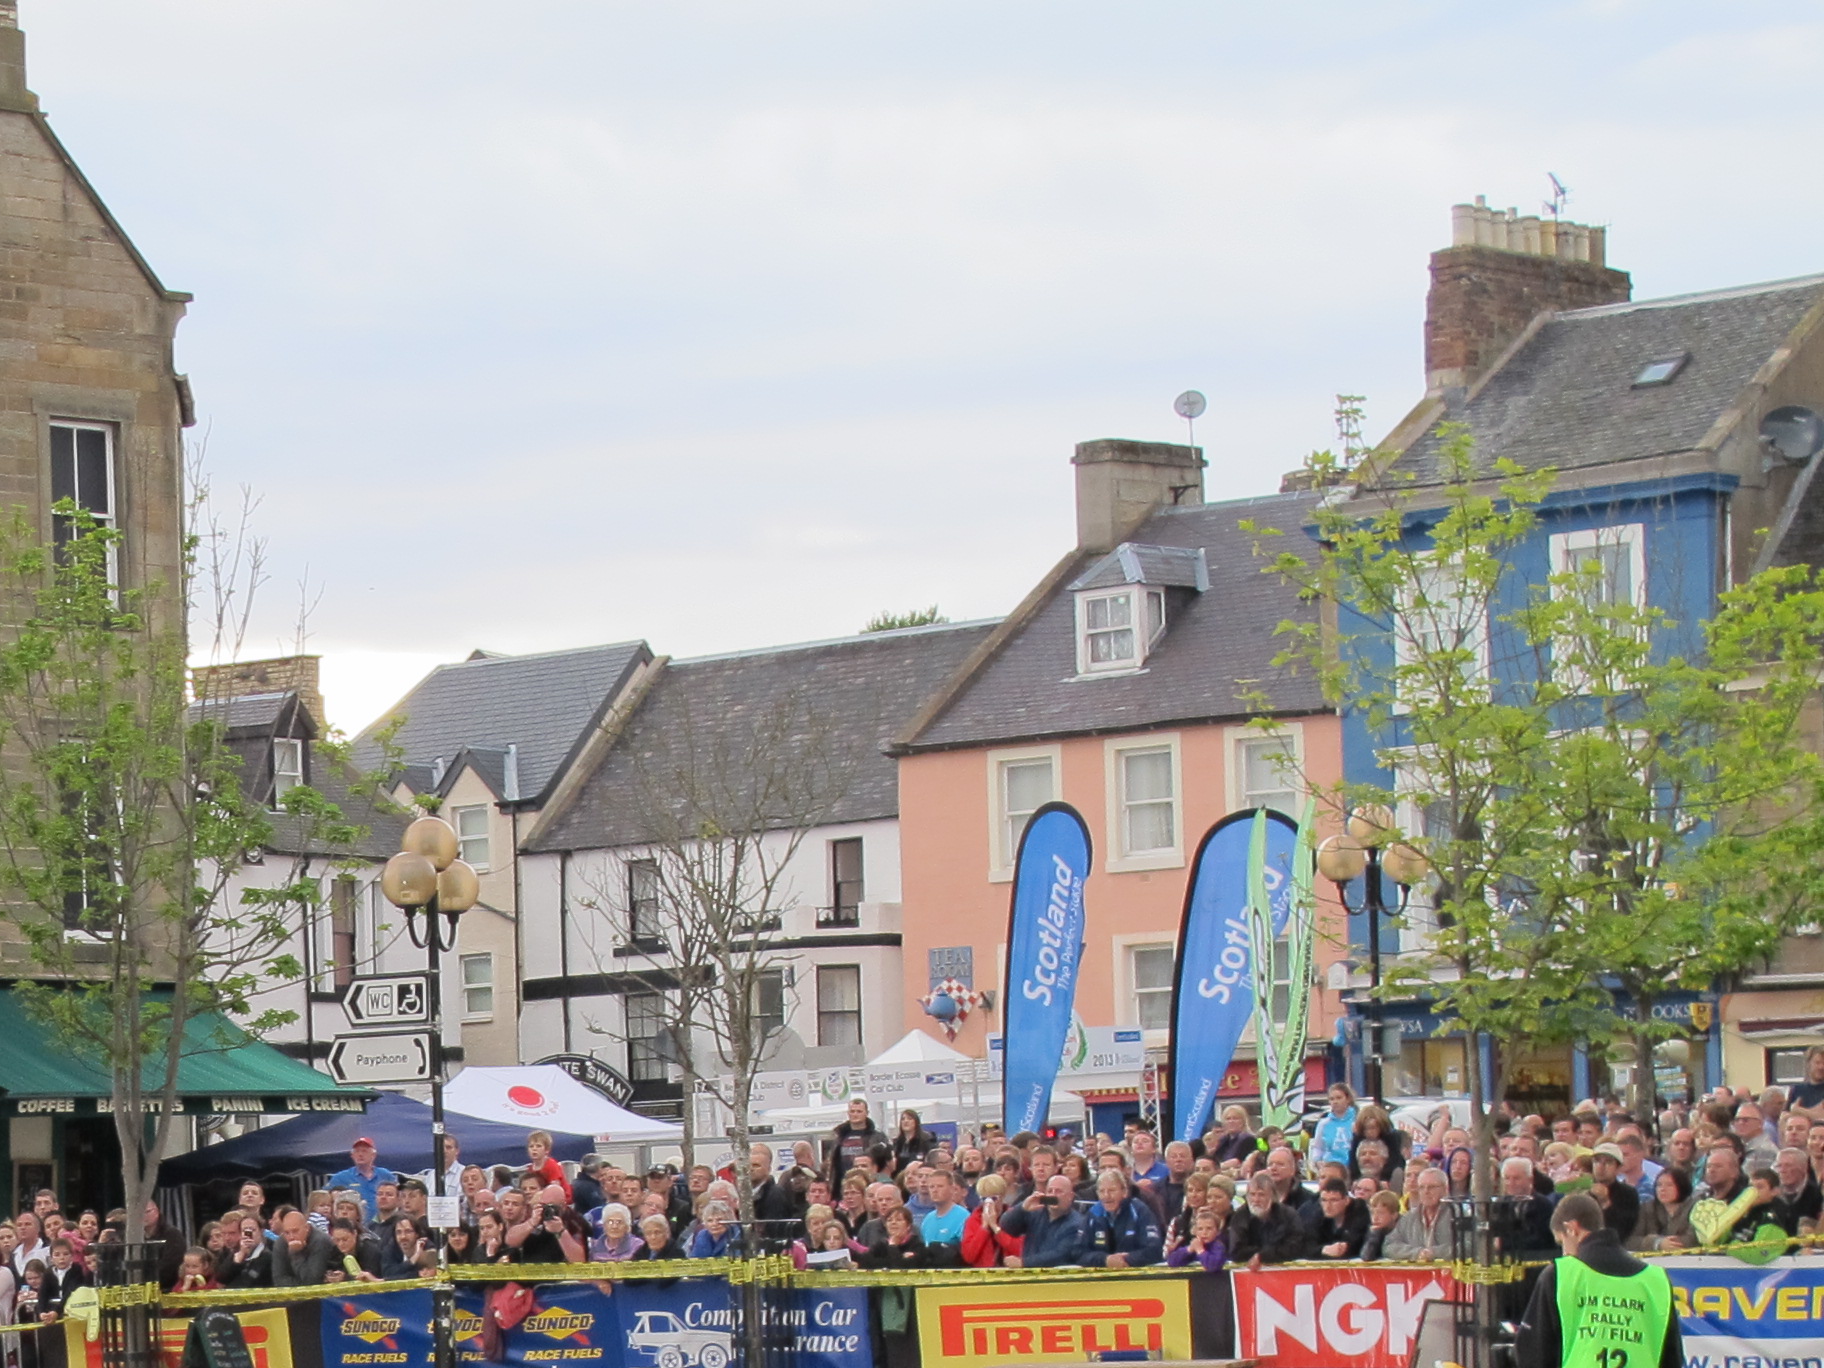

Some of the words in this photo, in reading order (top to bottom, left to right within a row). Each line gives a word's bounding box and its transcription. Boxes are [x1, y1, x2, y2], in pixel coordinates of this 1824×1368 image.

[1023, 854, 1072, 1006] Scotland
[934, 949, 966, 965] TEA
[370, 990, 391, 1010] WC
[1651, 1004, 1690, 1019] OOKS
[356, 1052, 408, 1066] Payphone
[1093, 1055, 1114, 1067] 2013
[586, 1067, 628, 1101] SWAN
[870, 1072, 892, 1082] Border
[871, 1084, 885, 1093] Car
[887, 1083, 905, 1093] Club
[17, 1100, 74, 1113] COFFEE
[212, 1099, 264, 1112] PANINI
[287, 1099, 309, 1111] ICE
[312, 1099, 363, 1112] CREAM
[1602, 1296, 1646, 1312] CLARK
[1673, 1286, 1824, 1321] RAVE
[526, 1314, 592, 1331] SUNOCO
[815, 1302, 858, 1327] Car
[1255, 1282, 1446, 1357] NGK
[1590, 1312, 1633, 1327] RALLY
[342, 1319, 399, 1334] SUNOCO
[939, 1298, 1165, 1357] PIRELLI
[1578, 1327, 1597, 1340] TV
[1610, 1329, 1644, 1344] FILM
[342, 1353, 371, 1364] RACE
[374, 1352, 408, 1363] FUELS
[524, 1350, 560, 1361] RACE
[563, 1347, 602, 1359] FUELS
